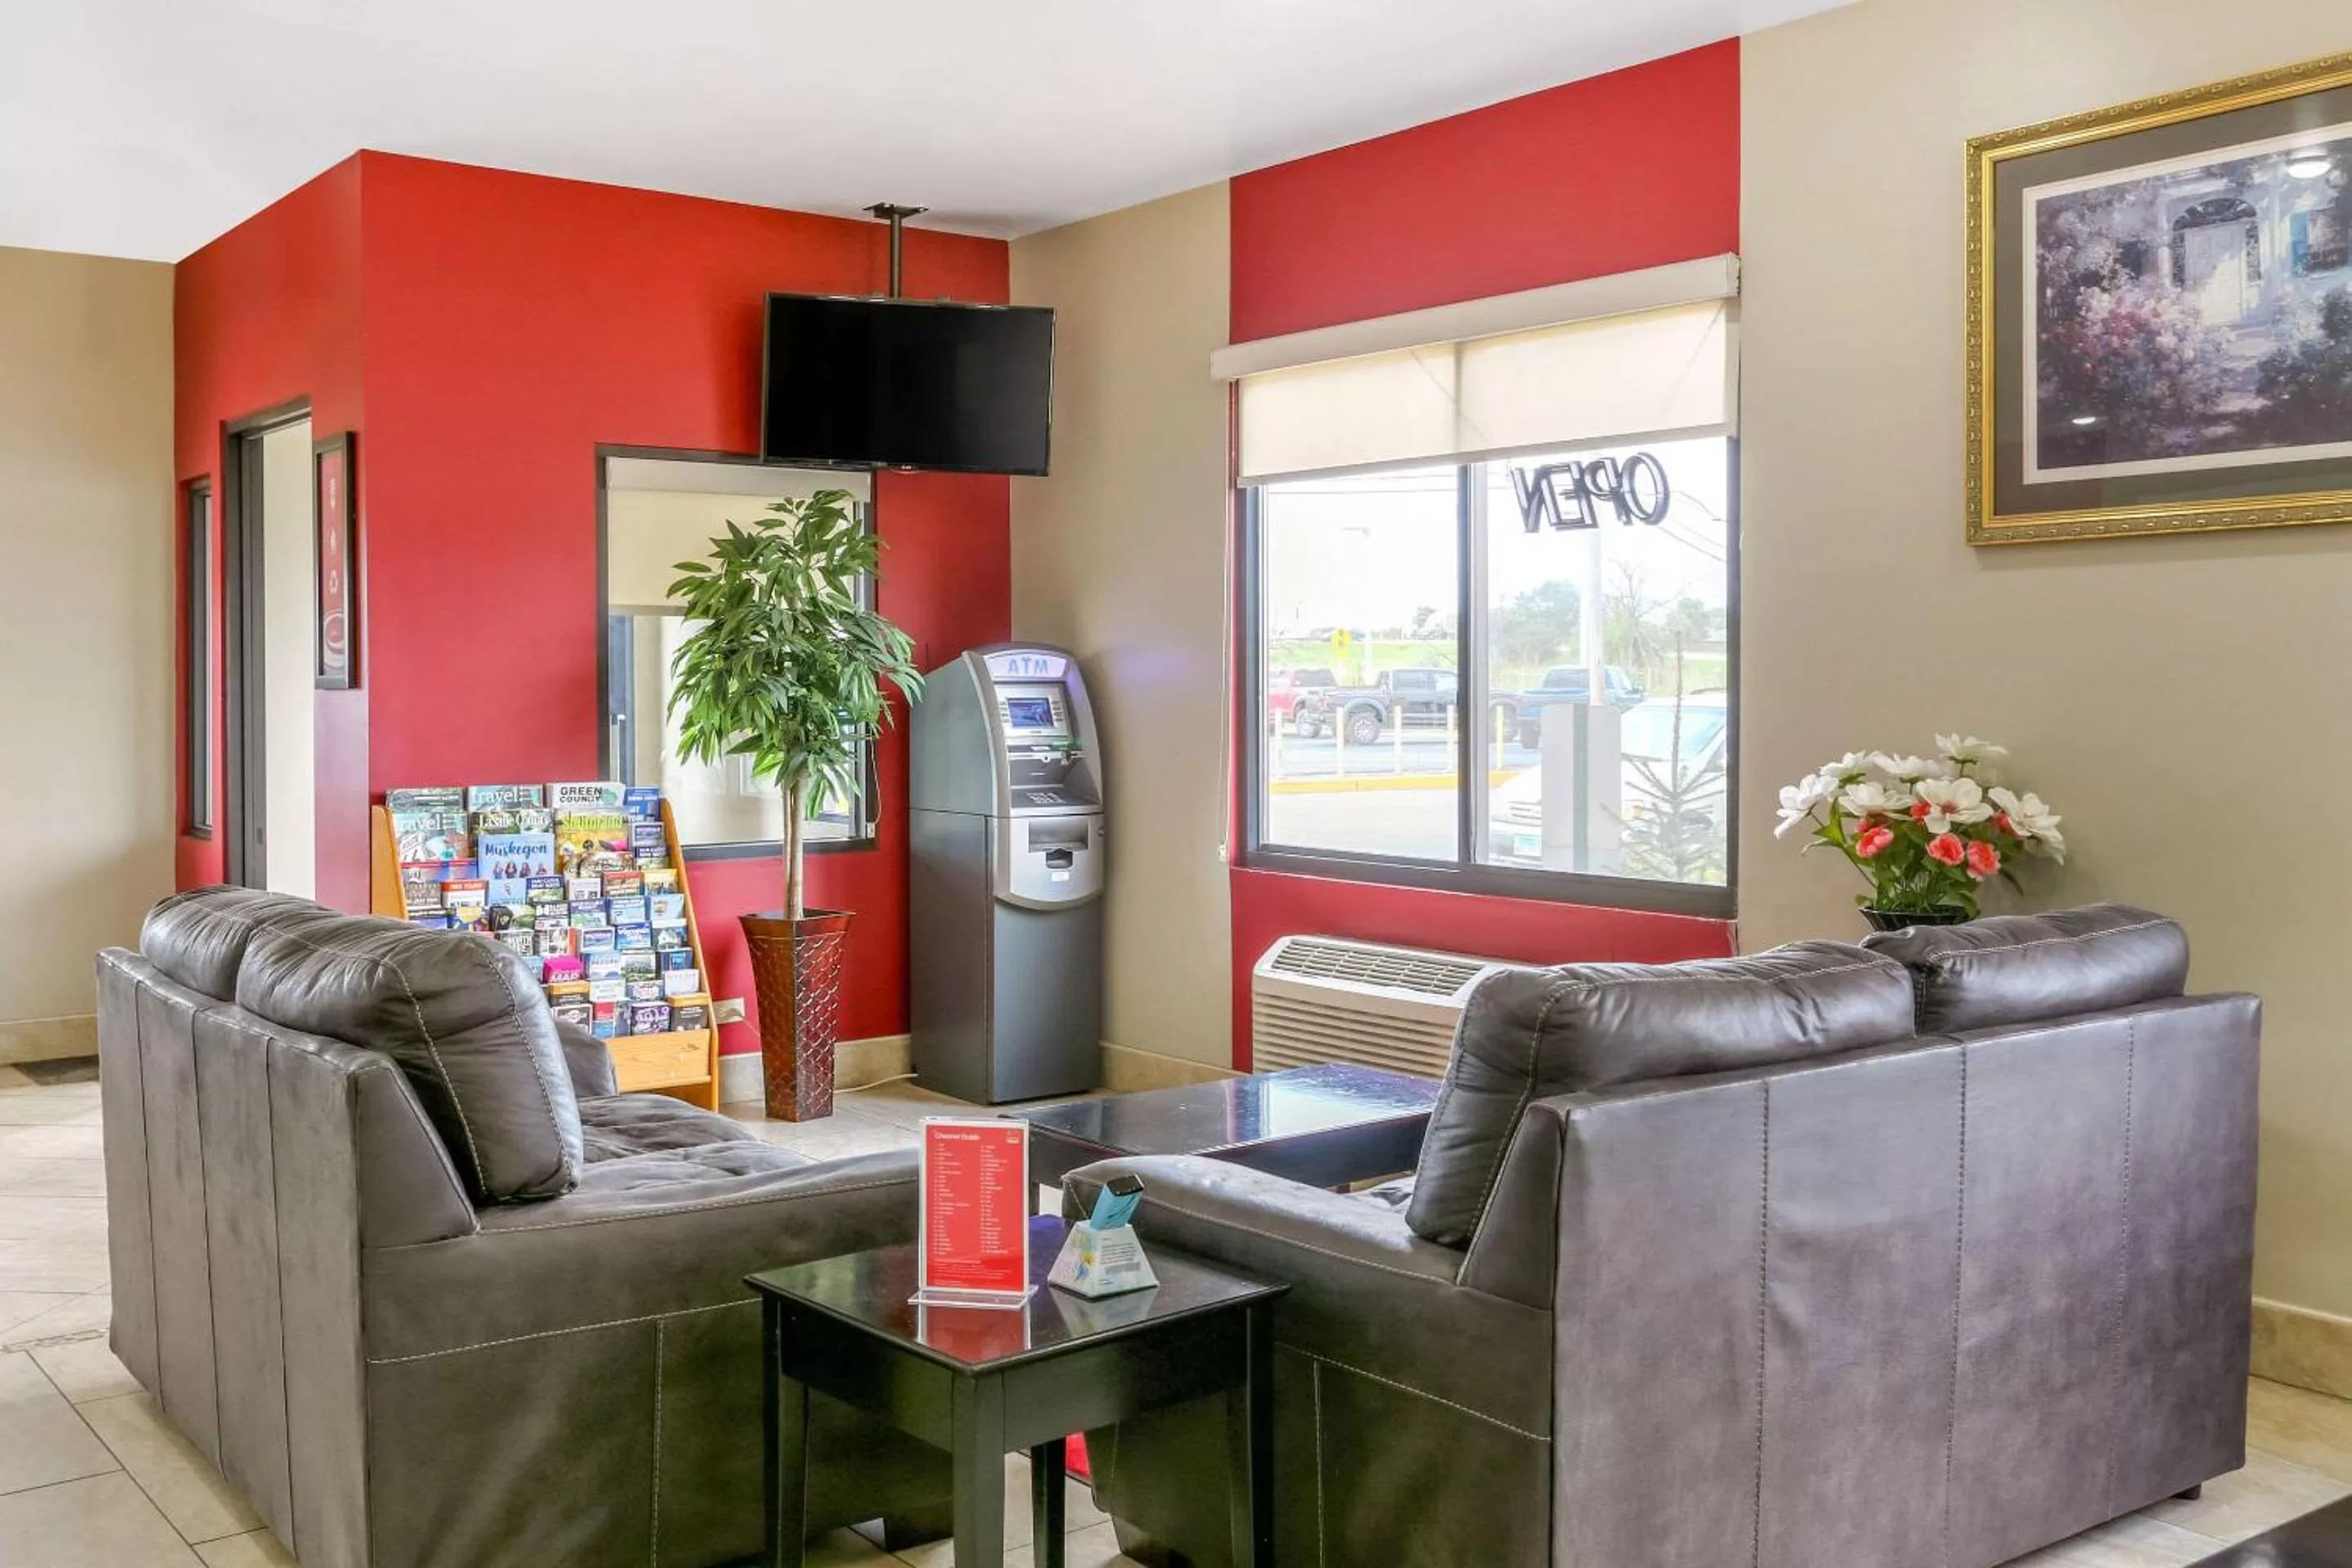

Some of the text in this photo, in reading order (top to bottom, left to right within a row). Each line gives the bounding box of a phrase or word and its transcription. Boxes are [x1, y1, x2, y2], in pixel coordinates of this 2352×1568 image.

[1008, 656, 1049, 675] ATM
[560, 786, 603, 796] GREEN
[485, 841, 547, 859] Muskegon
